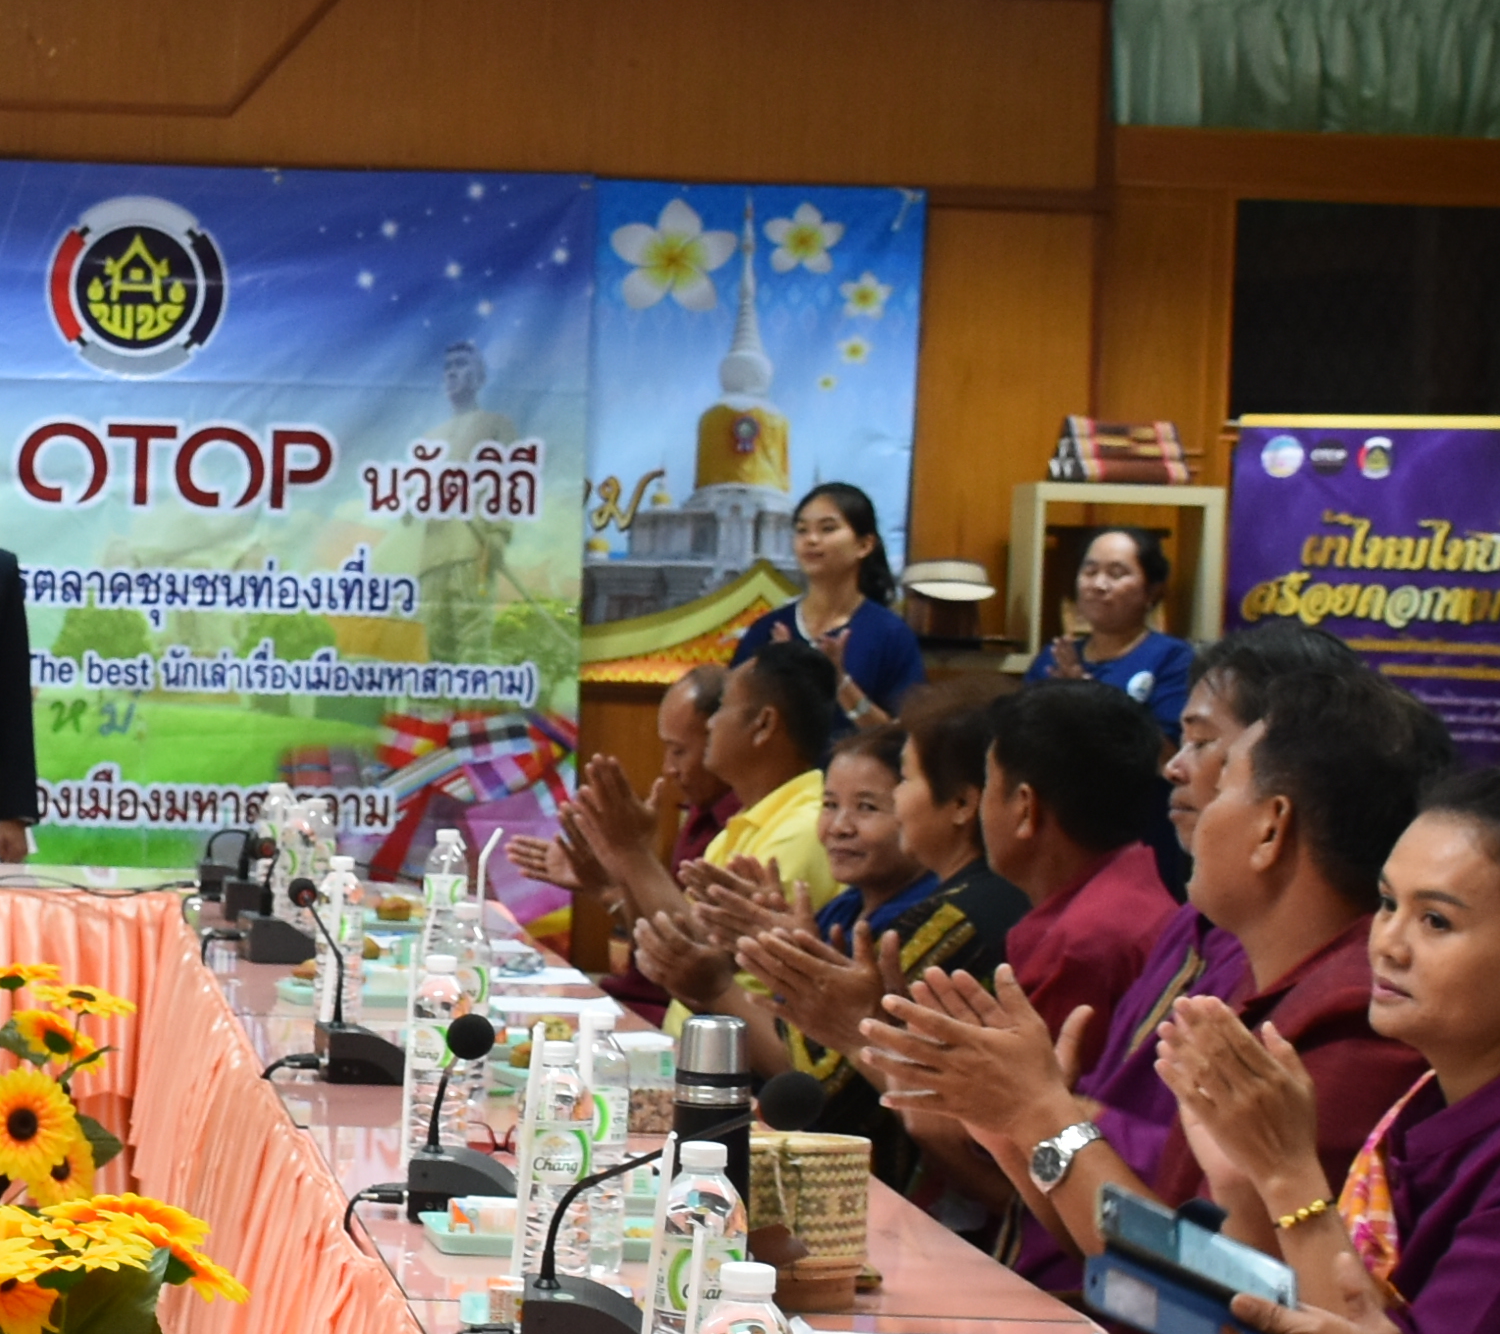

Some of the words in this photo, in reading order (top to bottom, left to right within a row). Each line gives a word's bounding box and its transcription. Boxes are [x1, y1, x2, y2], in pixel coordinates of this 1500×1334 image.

[17, 422, 333, 510] OTOP
[364, 444, 540, 516] นวัตวิถี
[18, 547, 416, 626] รตลาดชุมชนท่องเที่ยว
[88, 655, 148, 686] best
[533, 1157, 578, 1174] Chang
